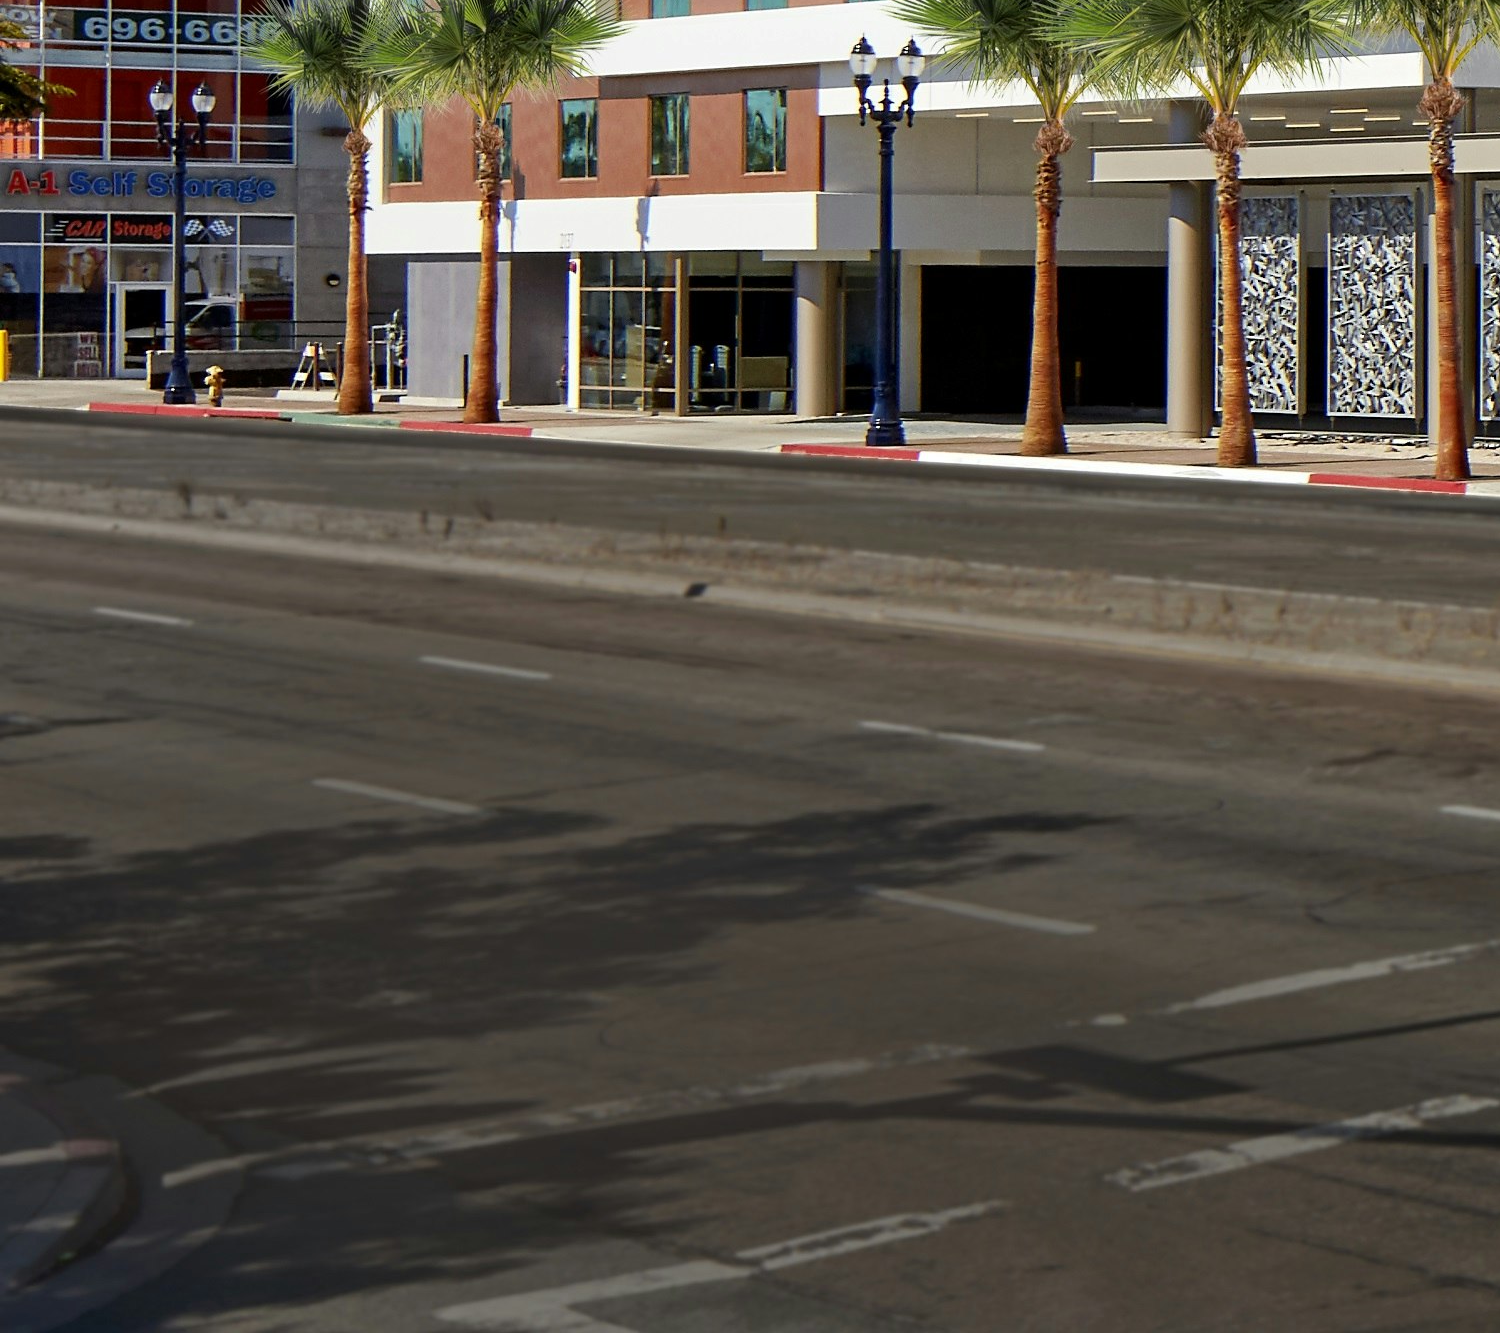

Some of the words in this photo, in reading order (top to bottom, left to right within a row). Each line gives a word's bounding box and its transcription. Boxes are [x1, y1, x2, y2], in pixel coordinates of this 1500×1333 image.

[7, 169, 60, 196] A-1
[68, 170, 138, 198] Self
[147, 172, 277, 204] Storage
[65, 219, 107, 237] CAR
[113, 221, 172, 240] Storage
